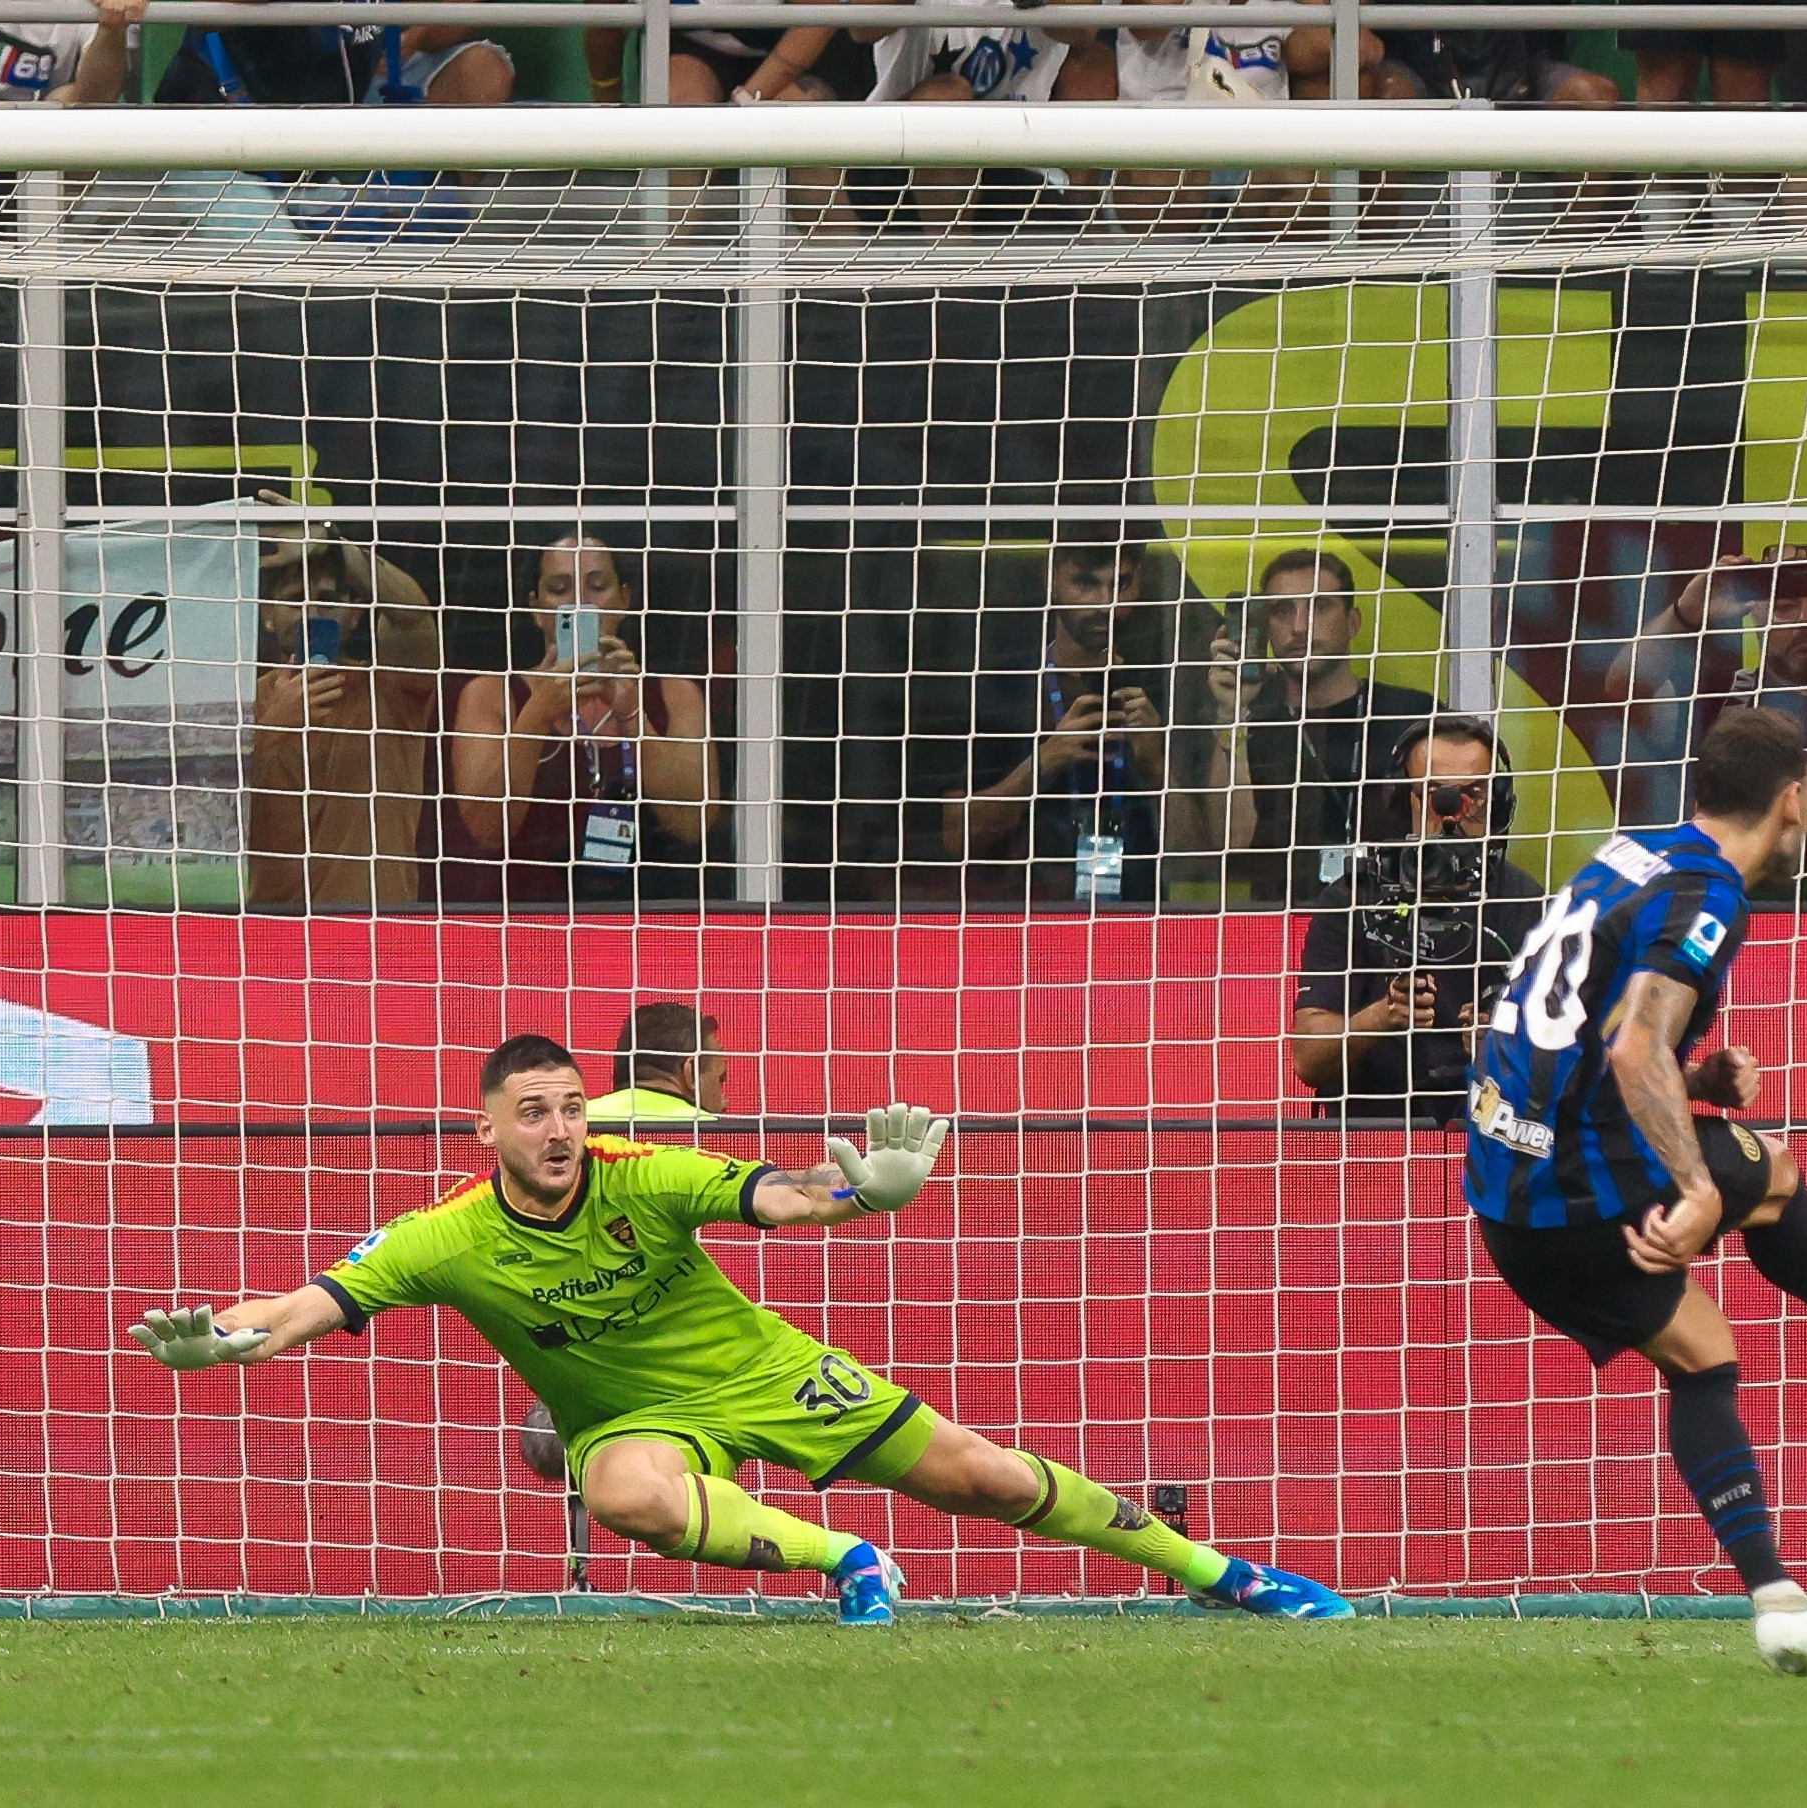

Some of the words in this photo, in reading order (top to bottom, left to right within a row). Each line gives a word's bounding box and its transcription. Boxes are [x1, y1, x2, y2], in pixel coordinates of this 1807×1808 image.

[531, 1267, 615, 1305] Betitaly
[571, 1254, 697, 1343] DEGHI
[792, 1351, 872, 1429] 30
